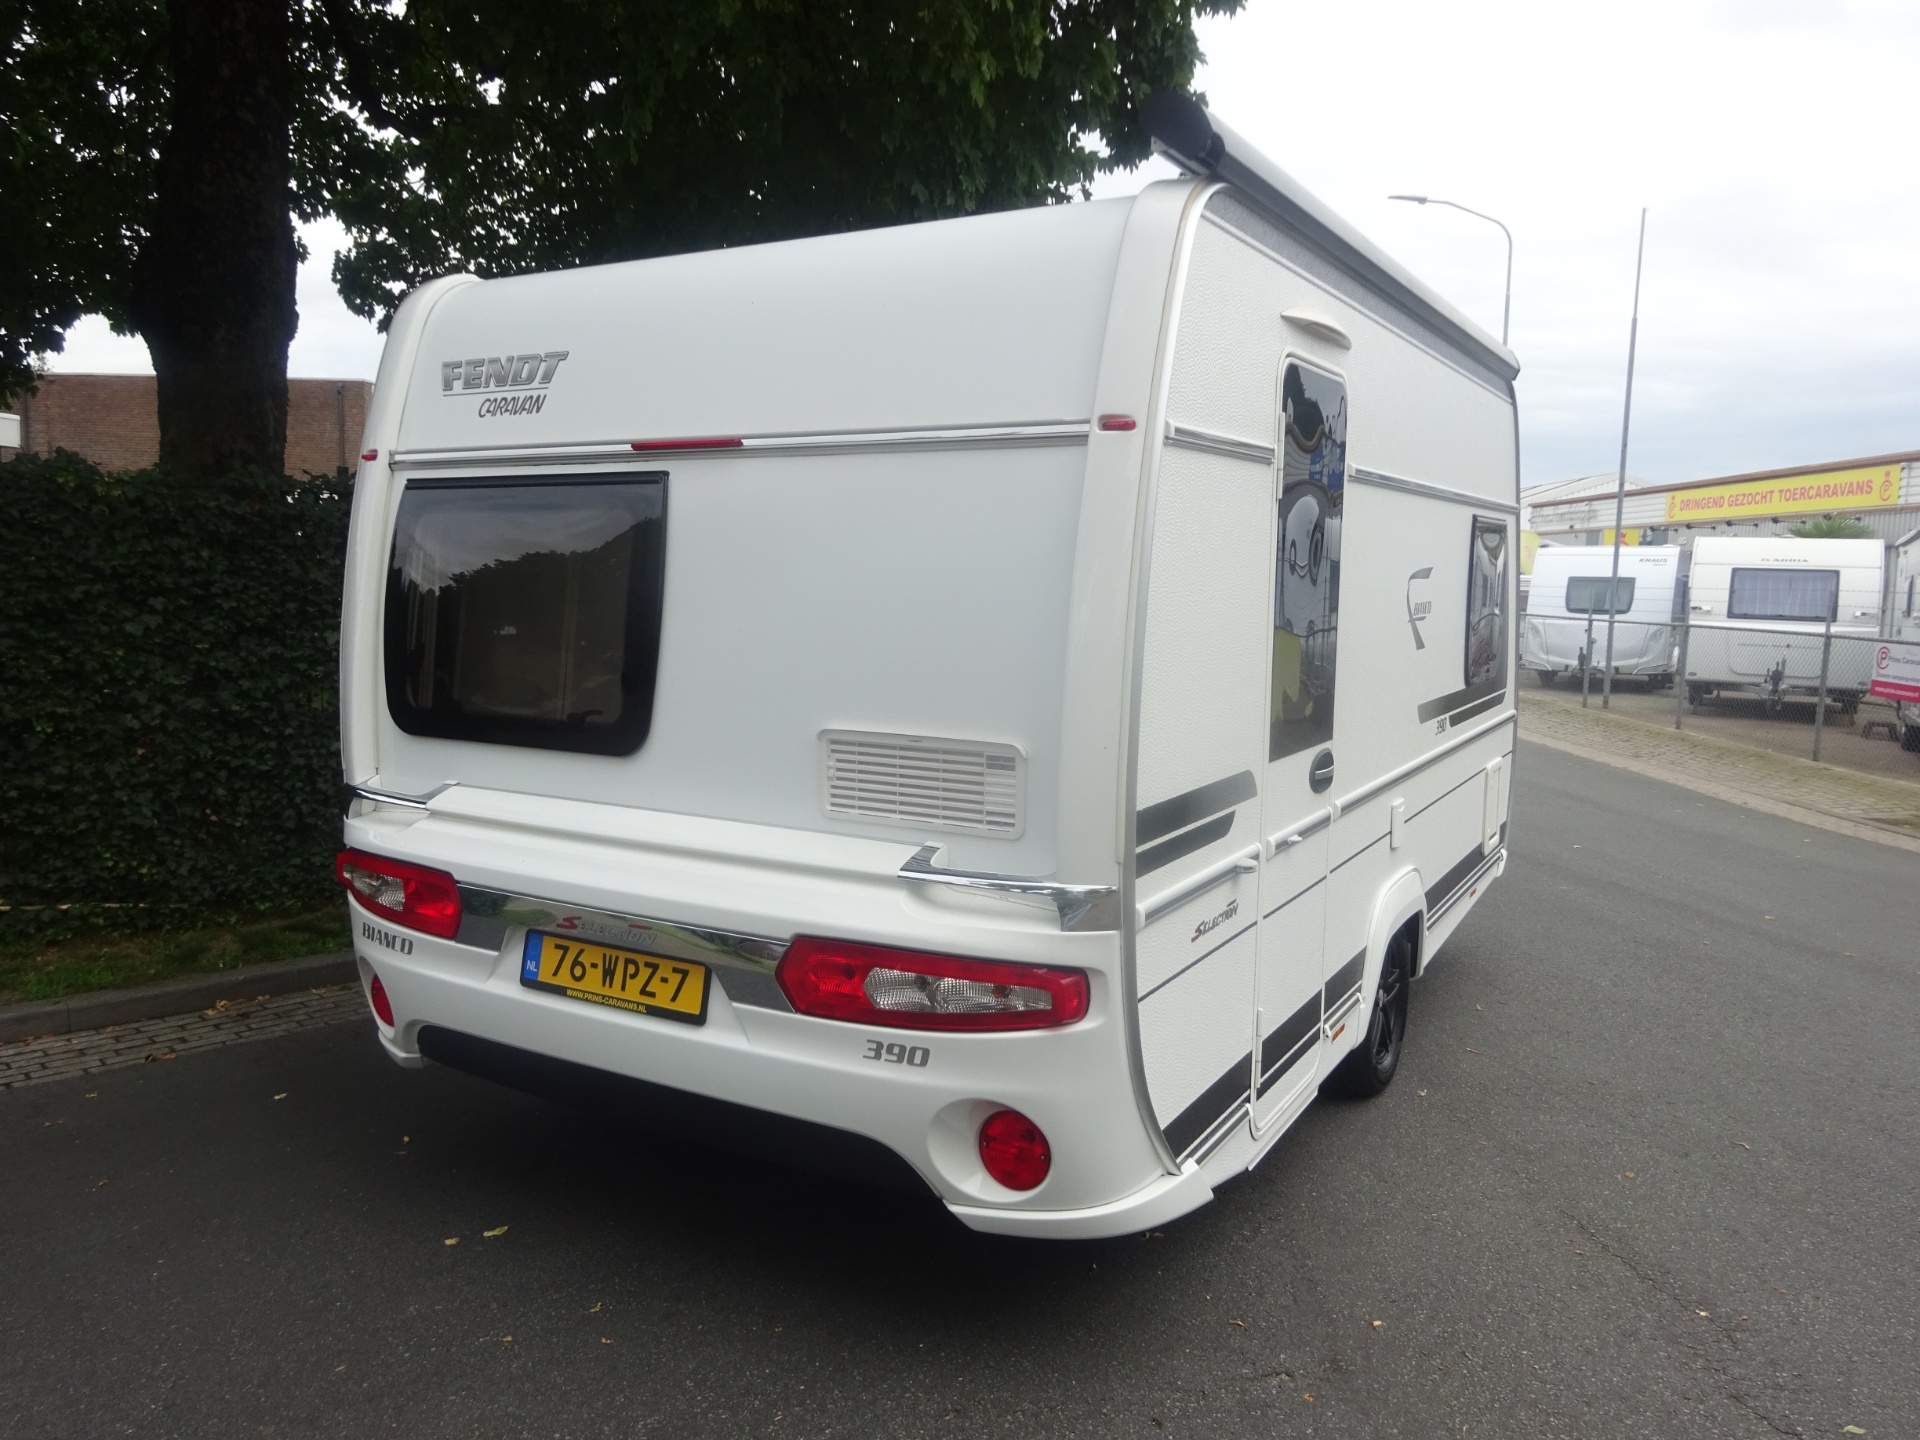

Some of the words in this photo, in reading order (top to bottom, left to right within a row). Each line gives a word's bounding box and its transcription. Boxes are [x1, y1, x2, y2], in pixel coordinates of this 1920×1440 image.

[442, 350, 569, 391] FENDT
[478, 394, 547, 418] CARAVAN
[1680, 496, 1725, 511] DRINGEND
[1728, 490, 1775, 507] GEZOCHT
[1778, 479, 1873, 502] TOERCARAVANS
[1413, 601, 1432, 616] BIANCO
[1435, 717, 1447, 736] 390
[362, 922, 414, 955] BIANCO
[527, 960, 538, 971] NL
[552, 943, 690, 1003] 76-WPZ-7
[566, 988, 647, 1013] WWW.PRINS-CARAVANS.NL
[863, 1039, 931, 1068] 390
